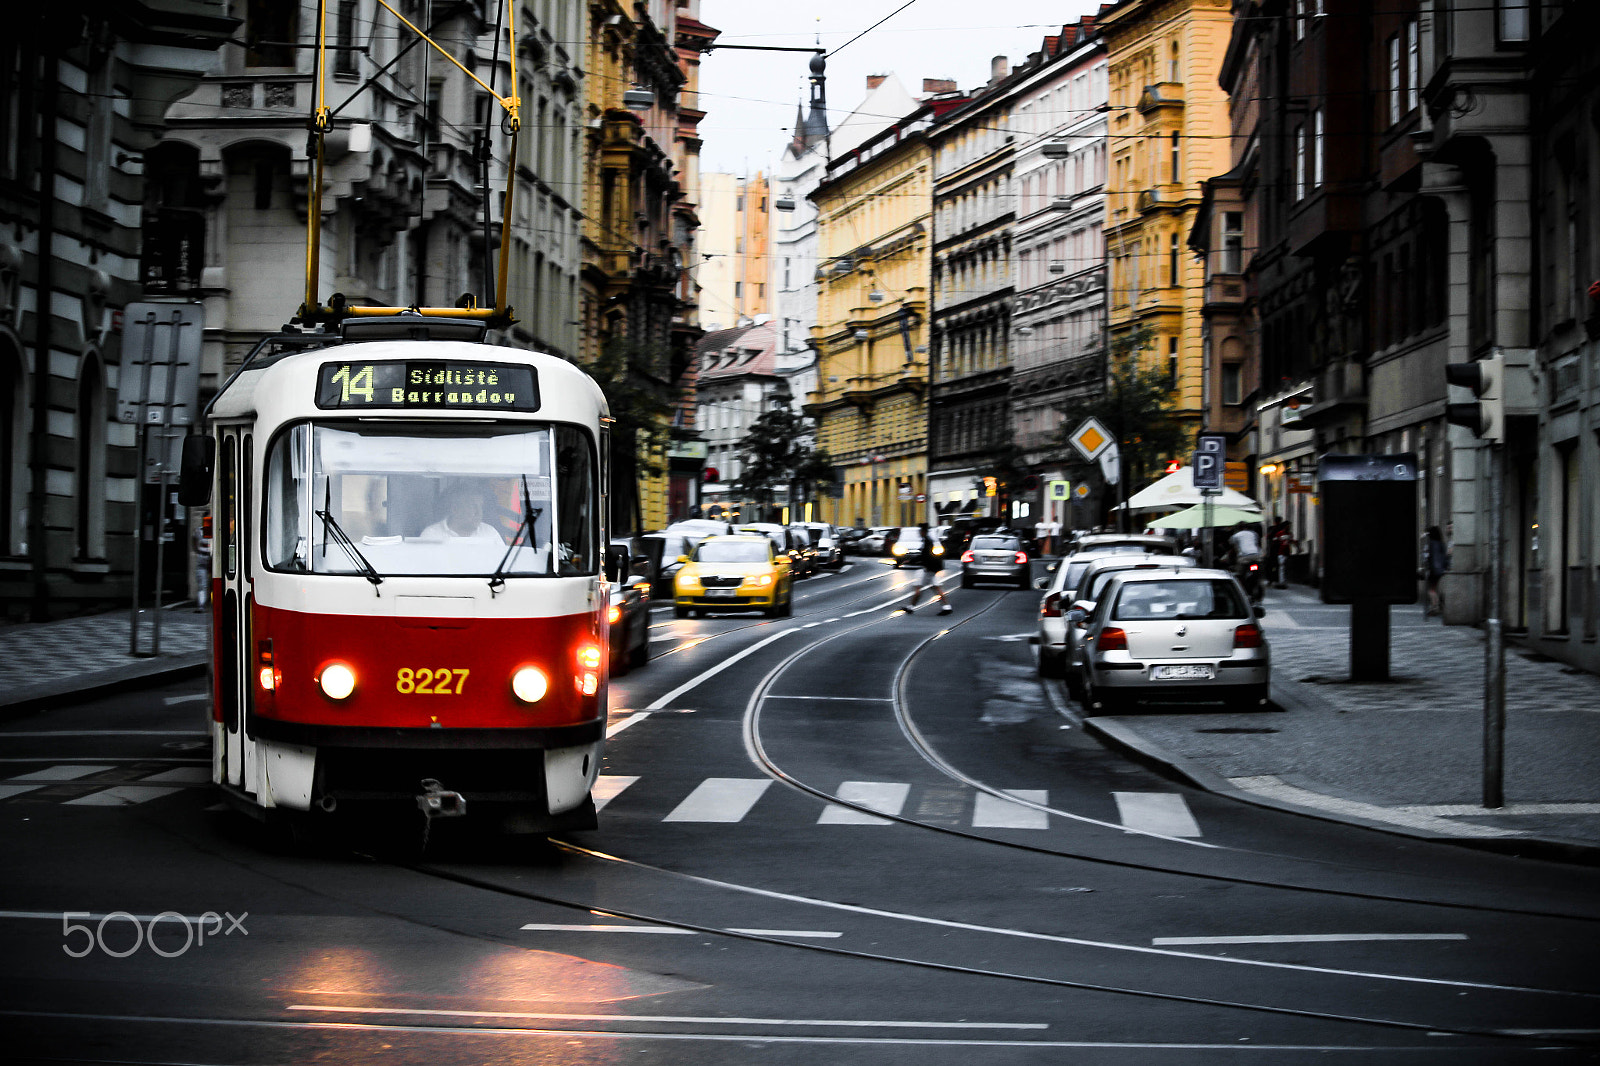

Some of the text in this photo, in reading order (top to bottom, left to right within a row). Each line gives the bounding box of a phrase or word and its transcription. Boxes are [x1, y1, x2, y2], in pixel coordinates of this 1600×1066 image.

[331, 365, 374, 402] 14
[410, 368, 499, 385] Sídliště
[392, 387, 515, 404] Barrandov
[1198, 455, 1215, 477] P
[396, 667, 470, 694] 8227
